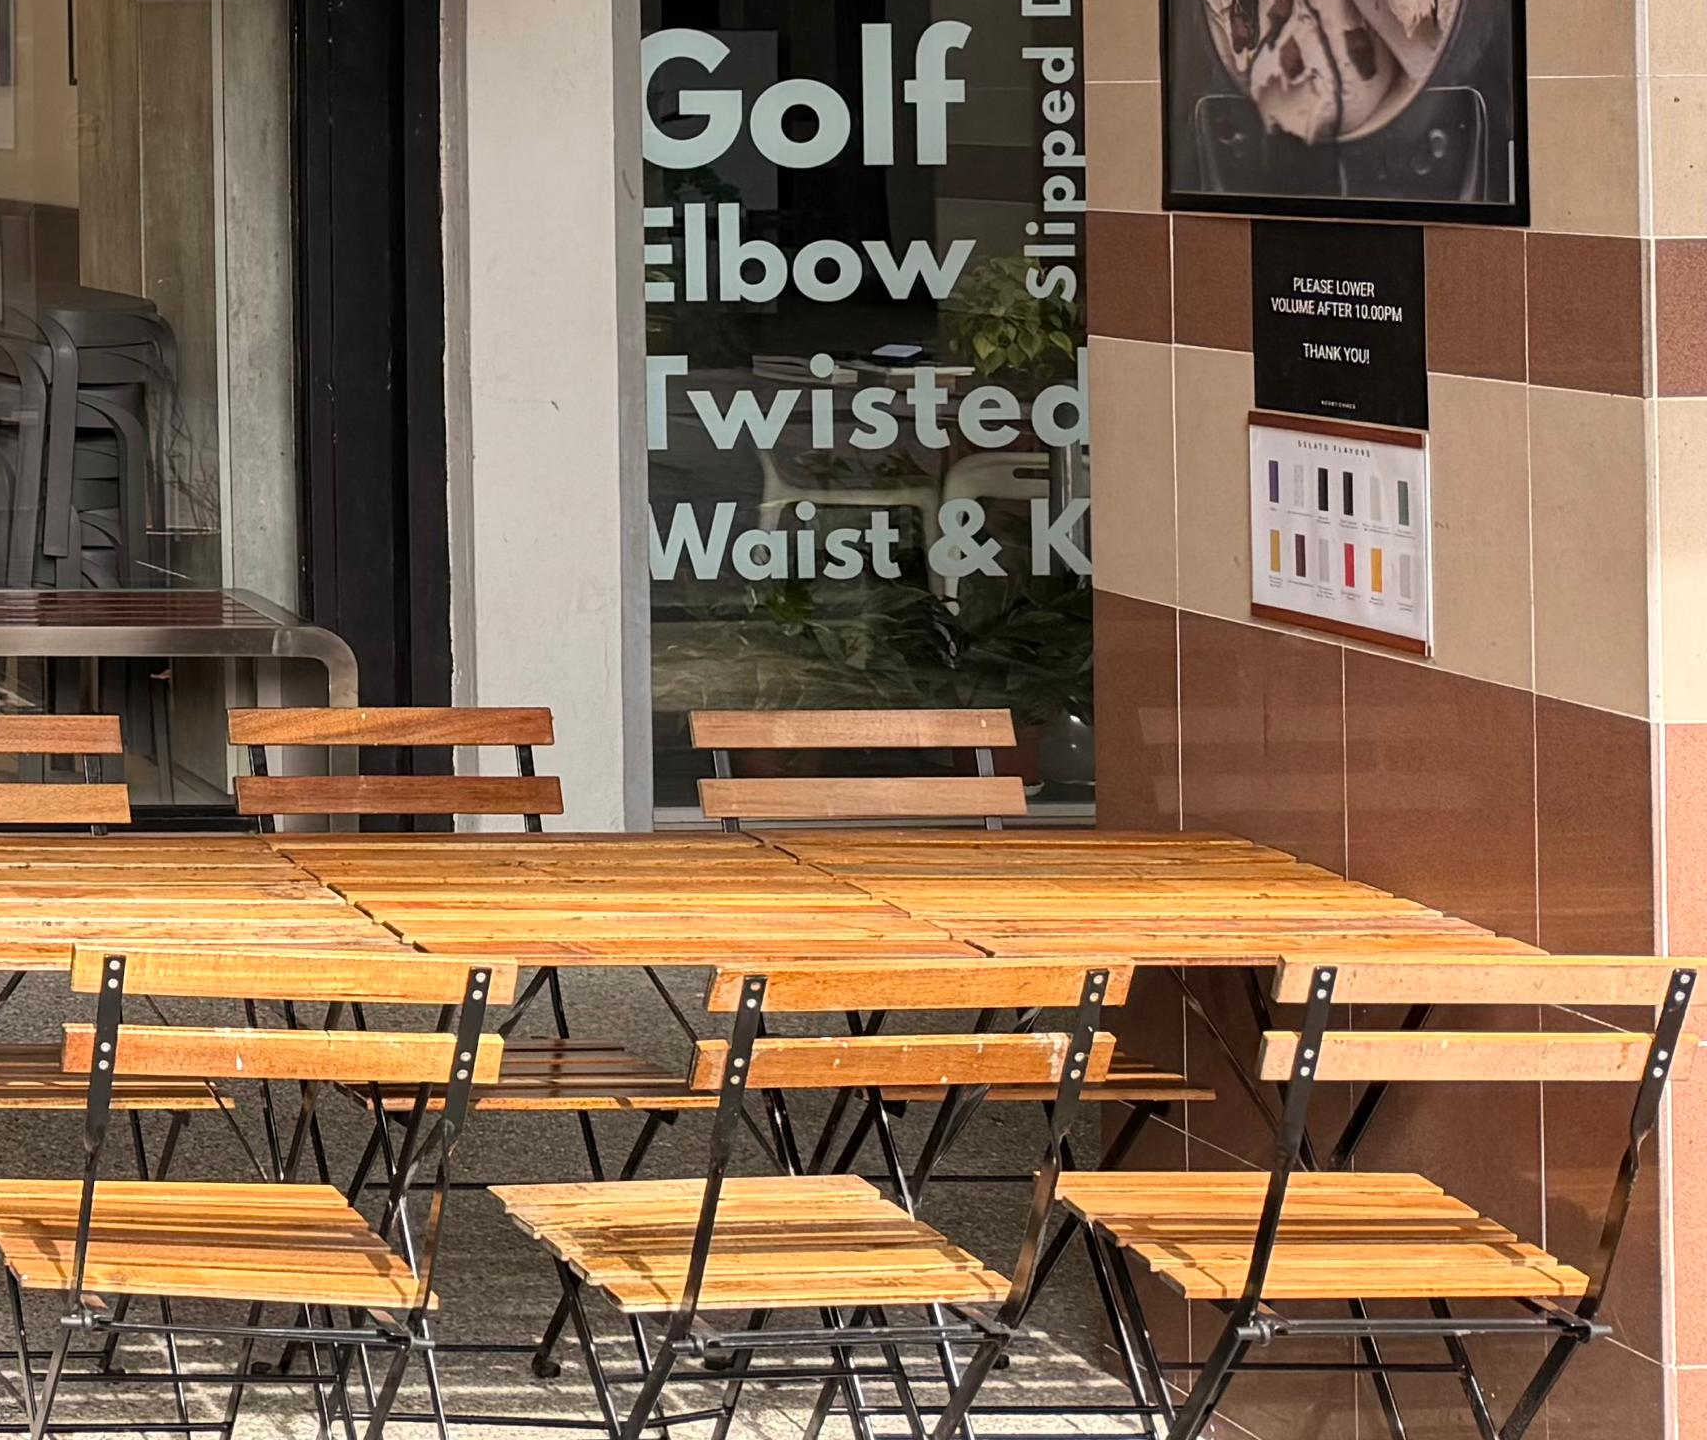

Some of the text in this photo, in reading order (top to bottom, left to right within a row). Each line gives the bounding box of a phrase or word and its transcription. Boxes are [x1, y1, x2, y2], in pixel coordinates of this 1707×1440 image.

[641, 20, 972, 169] Golf
[1023, 47, 1086, 303] Slipped
[643, 202, 977, 302] Elbow
[1293, 277, 1375, 298] PLEASE LOWER
[1271, 297, 1403, 323] VOLUME AFTER 10.00PM
[1303, 342, 1370, 365] THANK YOU!
[646, 347, 1090, 450] Twisted
[648, 501, 902, 581] Waist
[928, 498, 1008, 577] &
